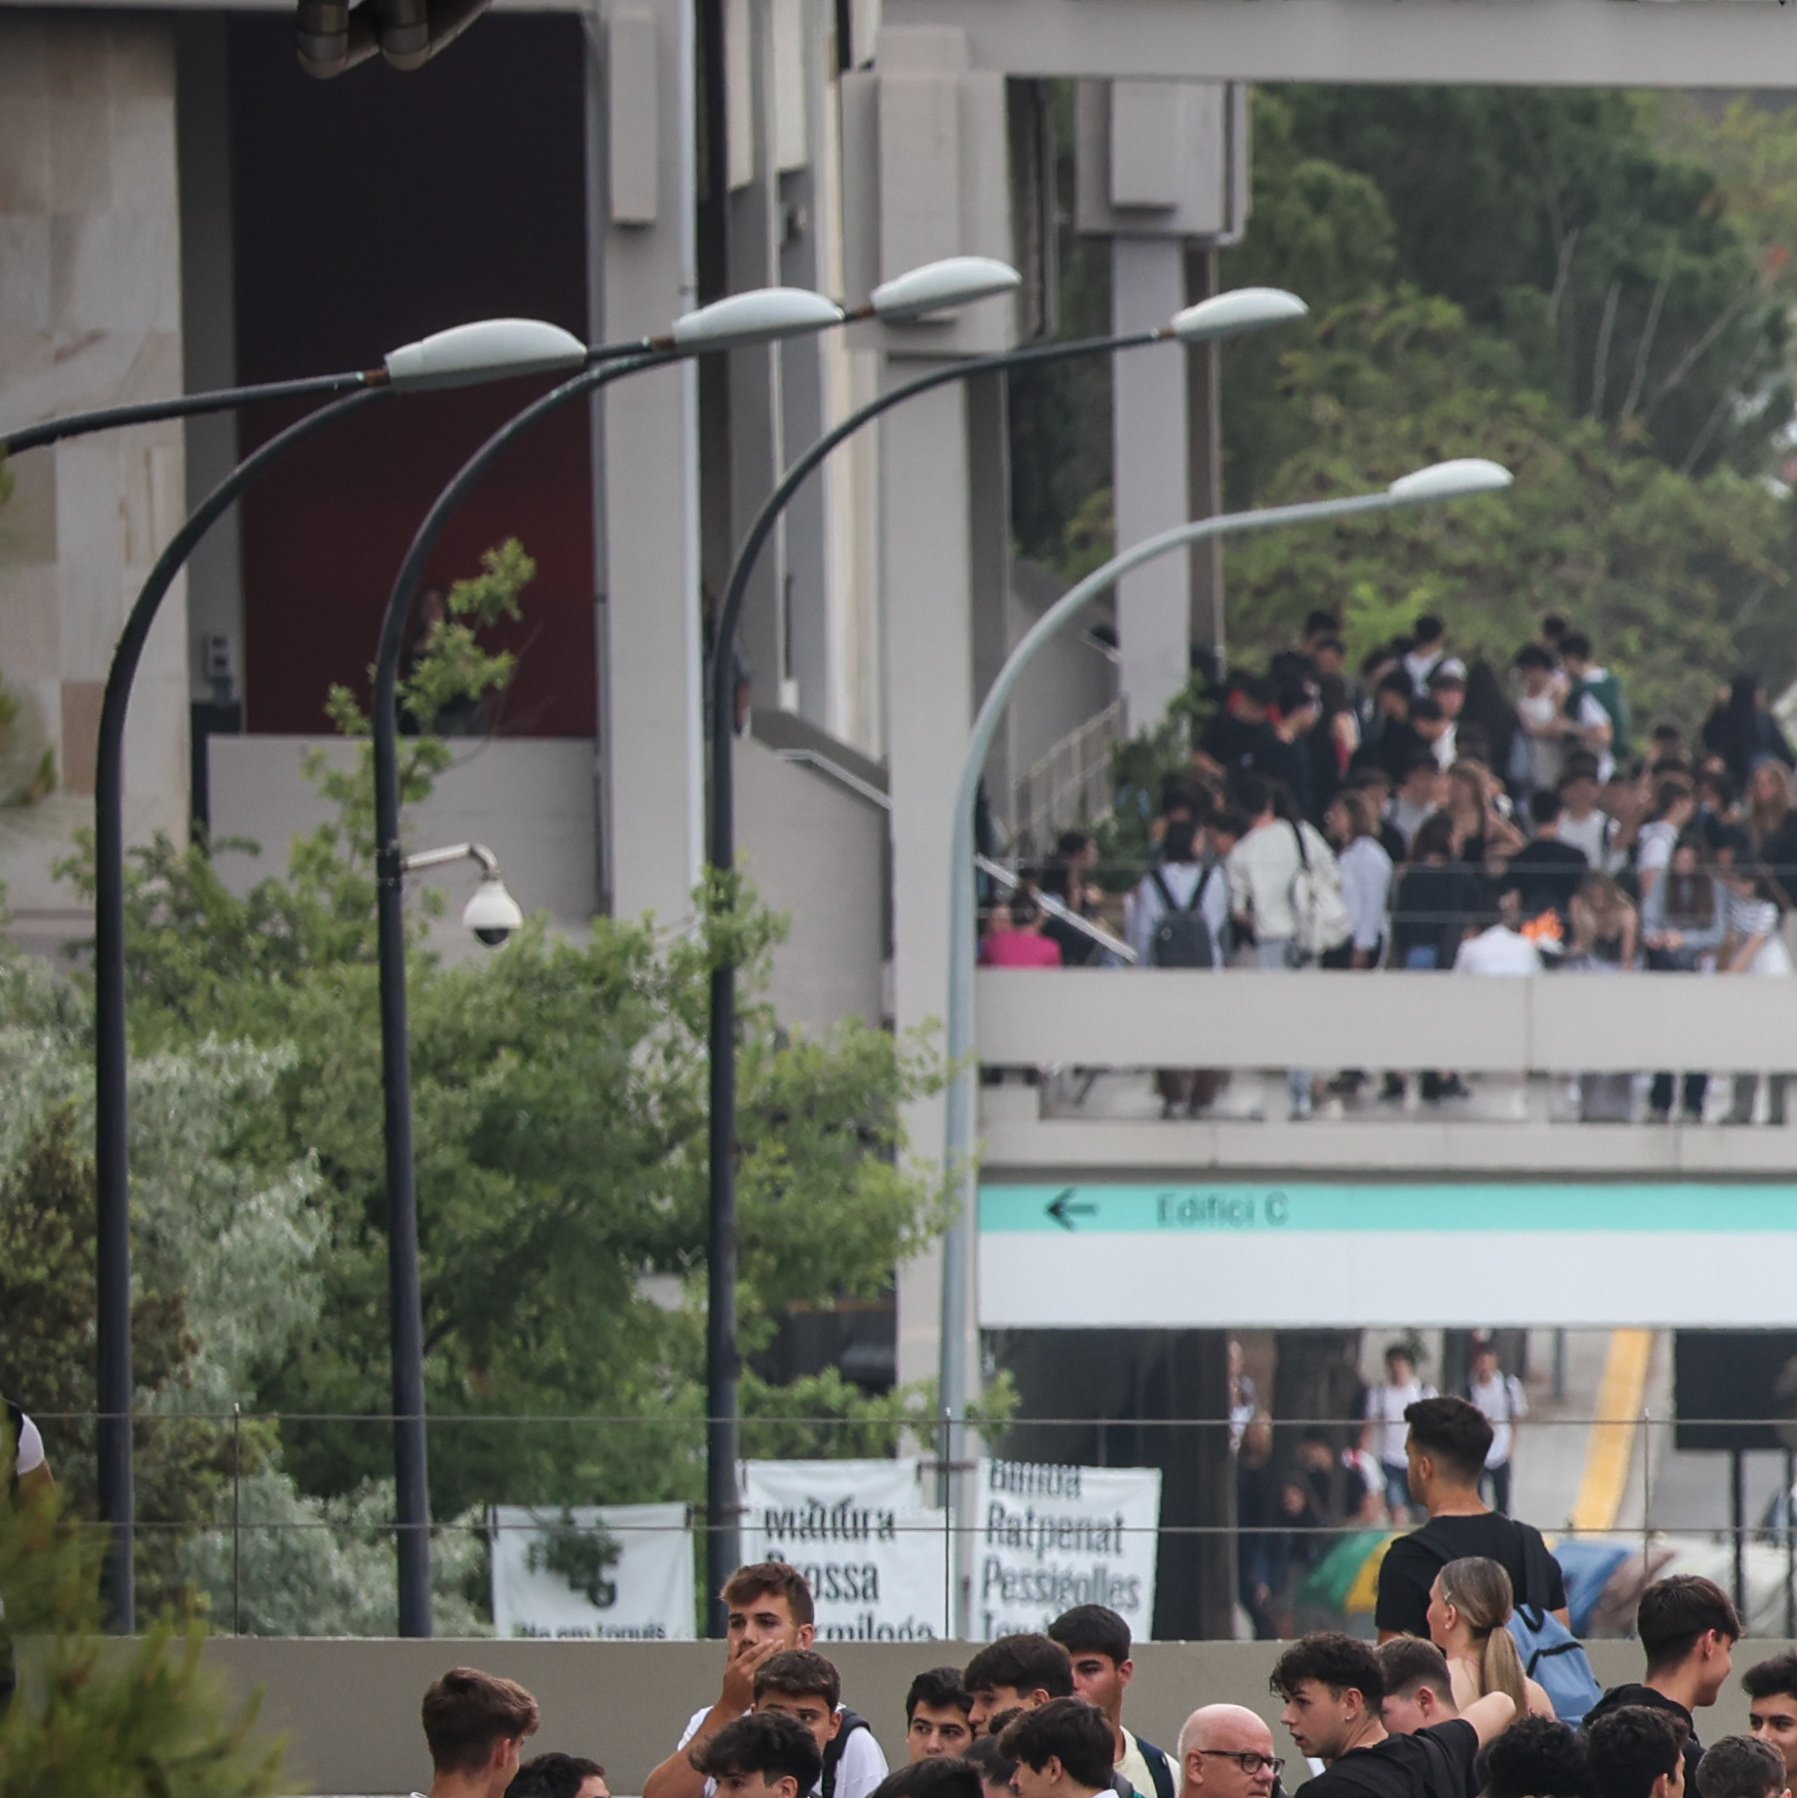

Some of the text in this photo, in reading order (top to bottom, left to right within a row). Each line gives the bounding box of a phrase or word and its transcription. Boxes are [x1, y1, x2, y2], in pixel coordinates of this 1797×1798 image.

[1155, 1190, 1289, 1228] Edifici C
[986, 1499, 1124, 1560] Ratpenat
[982, 1555, 1141, 1614] Pessigolles
